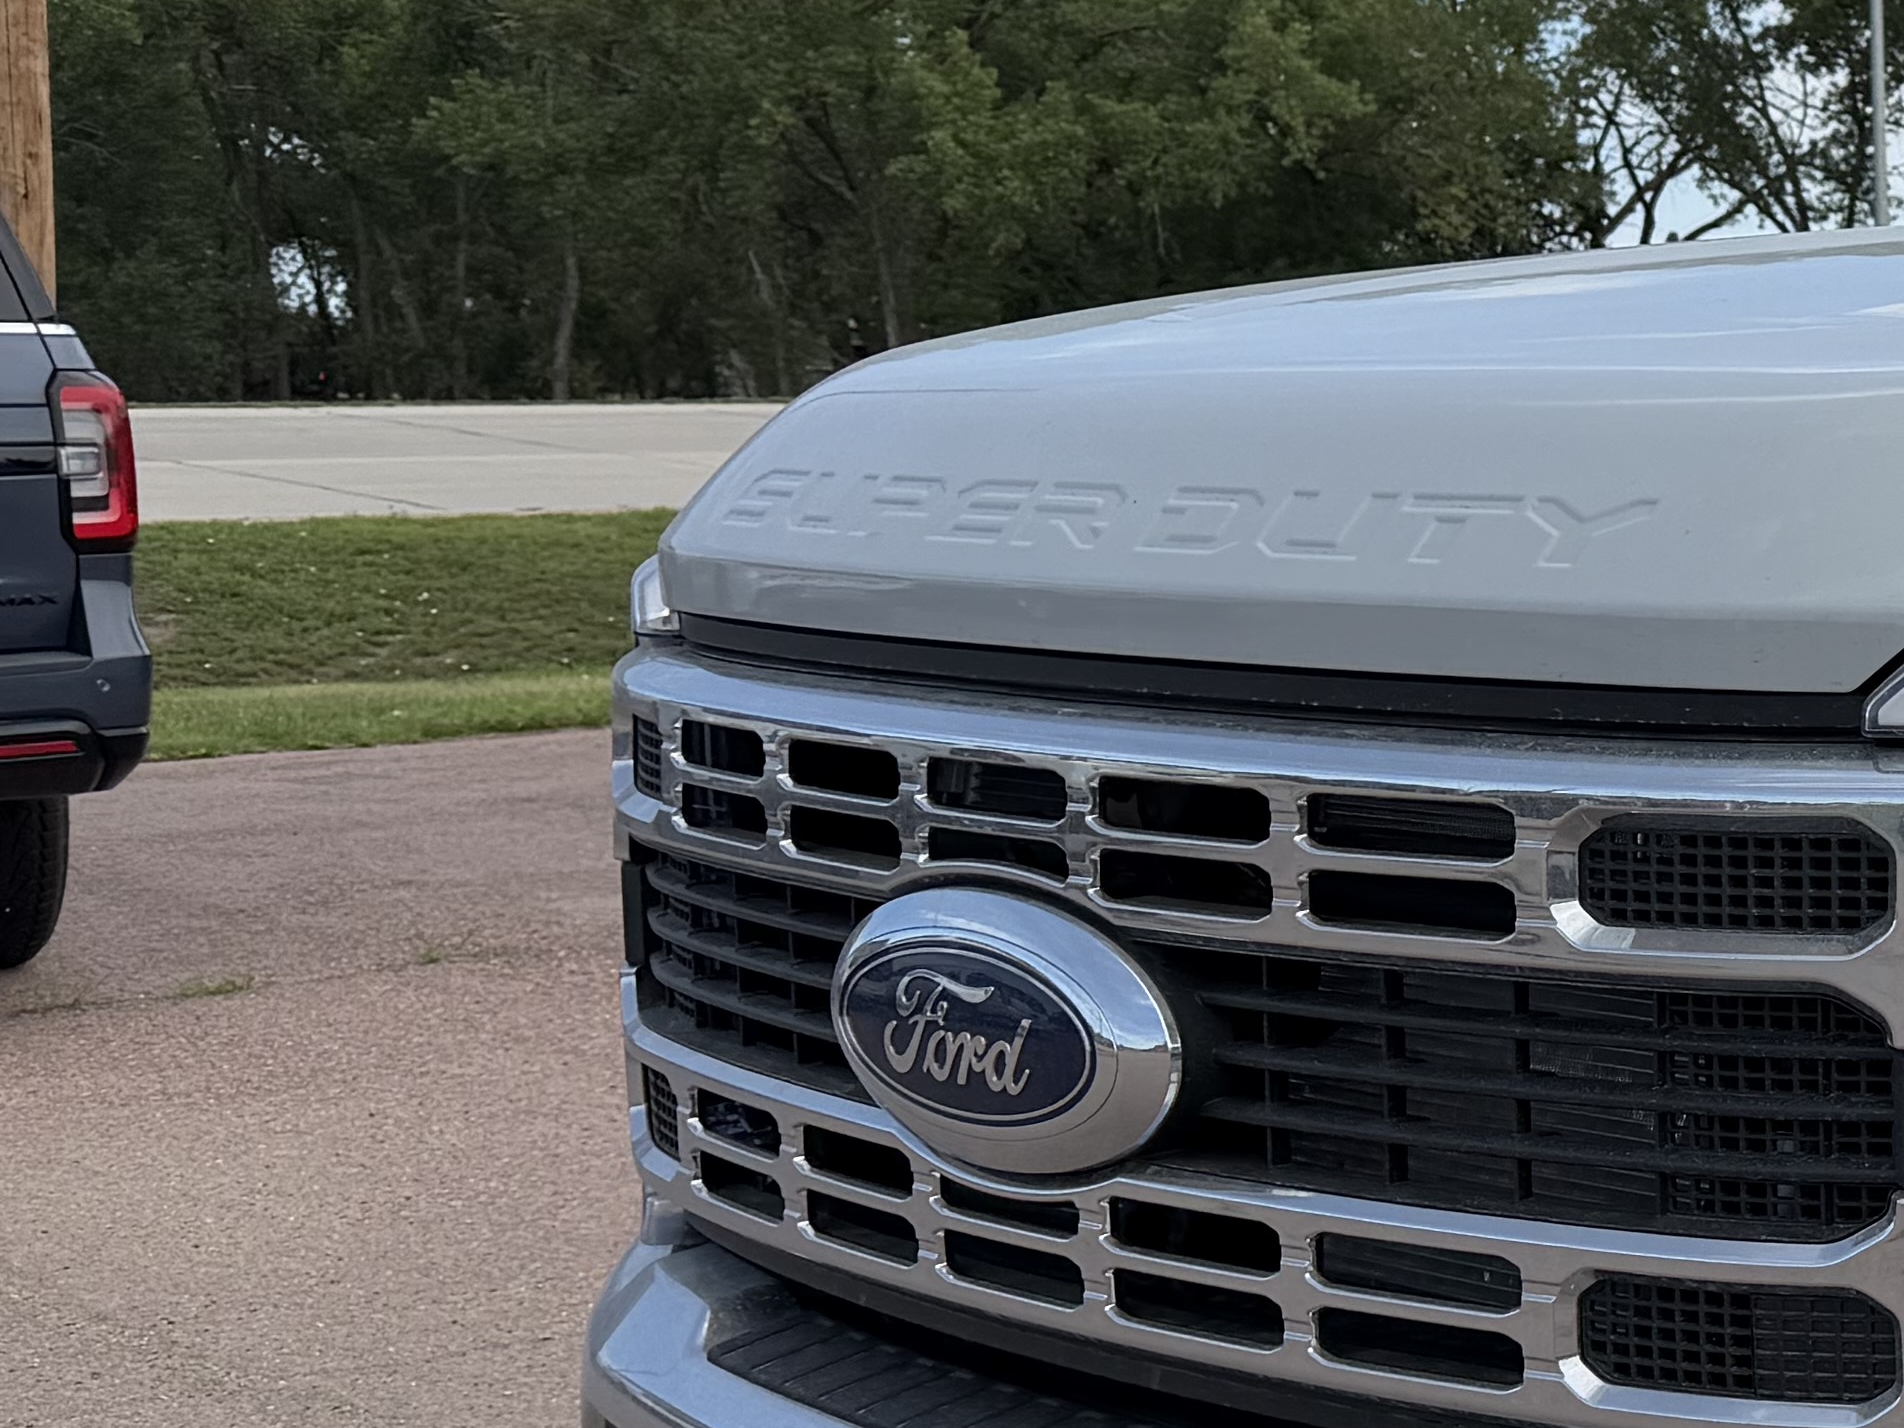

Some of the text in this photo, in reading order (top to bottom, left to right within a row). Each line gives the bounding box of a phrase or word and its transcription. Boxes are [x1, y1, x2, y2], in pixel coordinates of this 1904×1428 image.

[722, 468, 1660, 568] SUPER DUTY
[884, 968, 1031, 1096] Ford
